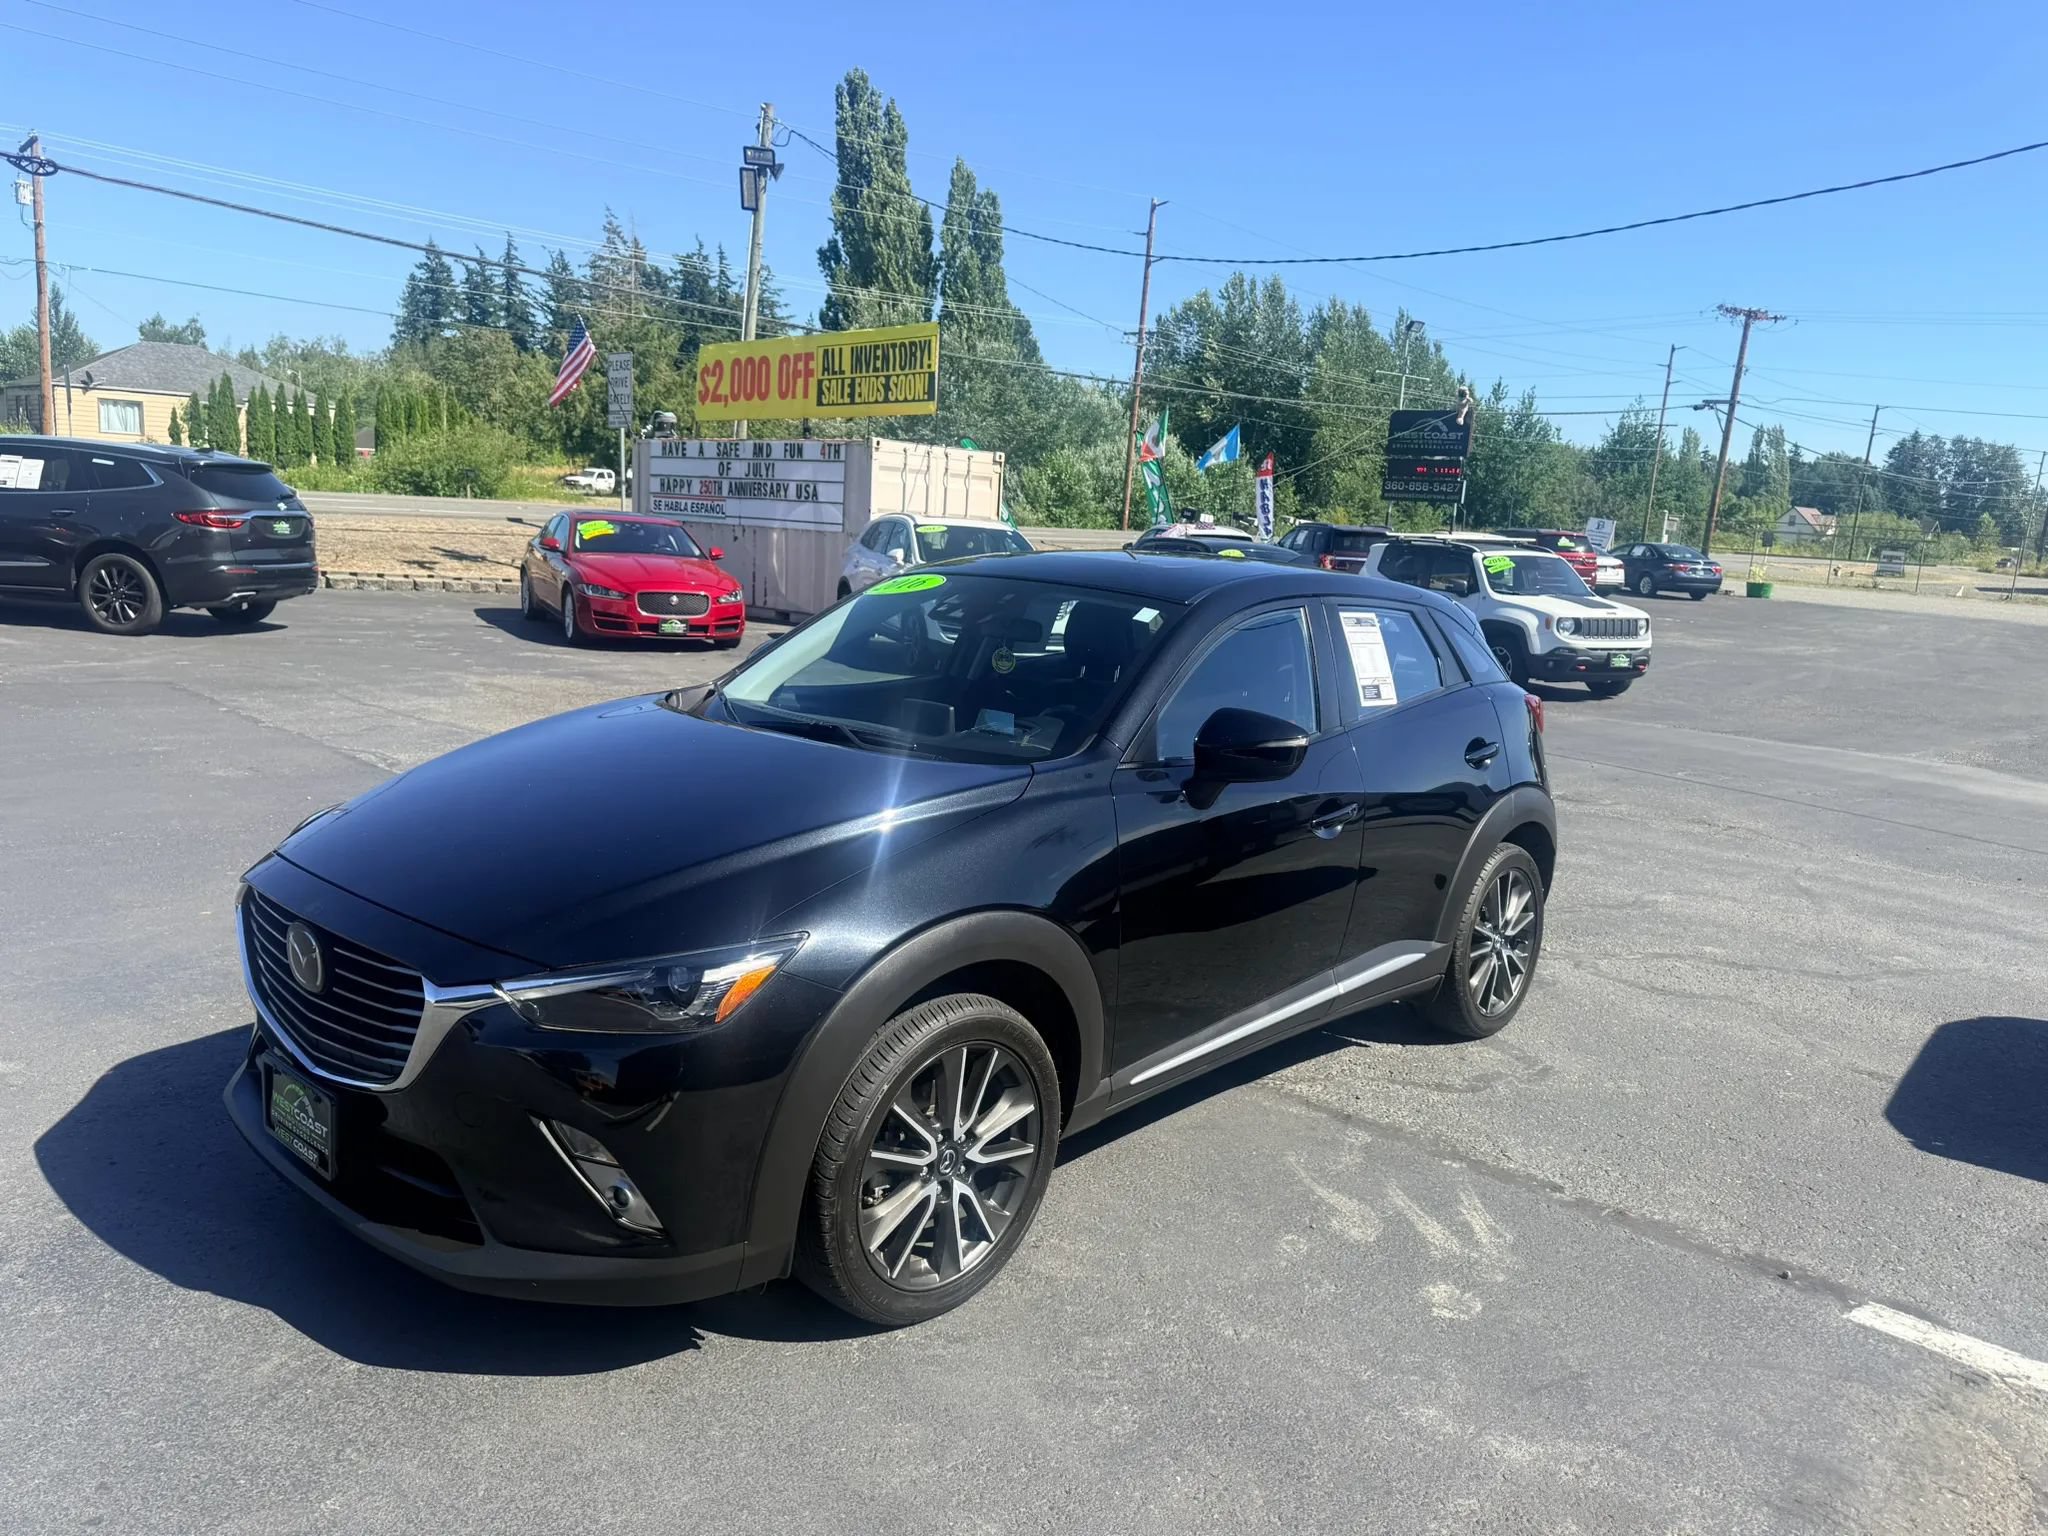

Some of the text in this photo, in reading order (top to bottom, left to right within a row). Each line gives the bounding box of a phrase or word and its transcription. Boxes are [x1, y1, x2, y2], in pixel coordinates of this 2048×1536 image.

[608, 359, 631, 372] PLEASE
[821, 338, 932, 377] ALL INVENTORY!
[610, 376, 629, 388] DRIVE
[698, 351, 815, 408] $2,000 OFF
[821, 372, 929, 405] SALE ENDS SOON!
[609, 393, 630, 405] SAFELY
[662, 441, 841, 460] HAVE A SAFE AND FUN 4TH
[718, 461, 775, 478] OF JULY!
[660, 478, 819, 501] HAPPY 250TH ANNIVERSARY USA
[653, 499, 726, 516] SE HABLA ESPAÑOL
